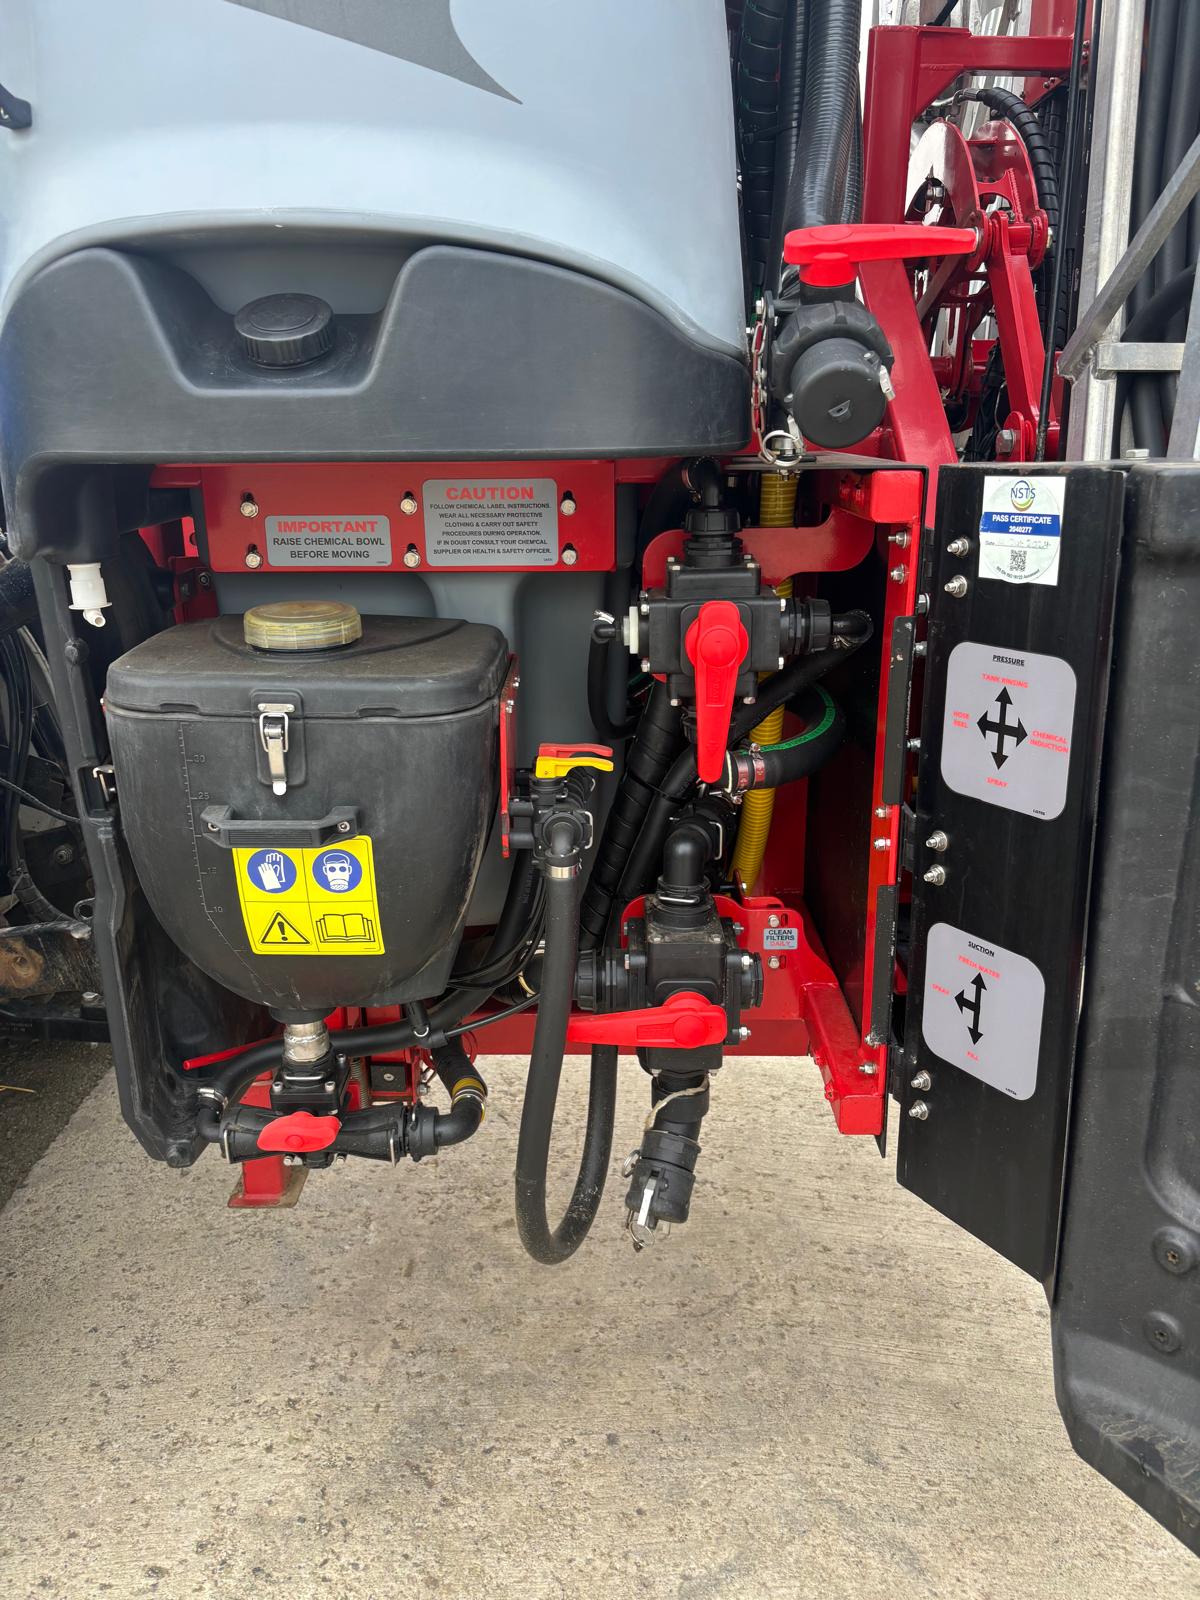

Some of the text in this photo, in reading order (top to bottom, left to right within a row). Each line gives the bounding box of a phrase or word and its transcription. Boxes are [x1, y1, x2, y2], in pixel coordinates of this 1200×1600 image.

[446, 487, 534, 500] CAUTION
[1011, 487, 1036, 499] NSTS
[992, 514, 1051, 524] PASS CERTIFICATE
[277, 521, 378, 533] IMPORTANT
[273, 537, 385, 546] RAISE CHEMICAL BOWL
[992, 655, 1025, 667] PRESSURE
[982, 673, 1029, 689] TANK RINSING
[1032, 730, 1068, 743] CHEMICAL
[1029, 739, 1069, 753] INDUCTION
[193, 755, 206, 763] 30
[986, 777, 1008, 788] SPRAY
[198, 792, 210, 800] 25
[968, 941, 994, 957] SUCTION
[978, 963, 1000, 979] WATER
[932, 983, 950, 996] SPRAY
[966, 1051, 980, 1062] FILL
